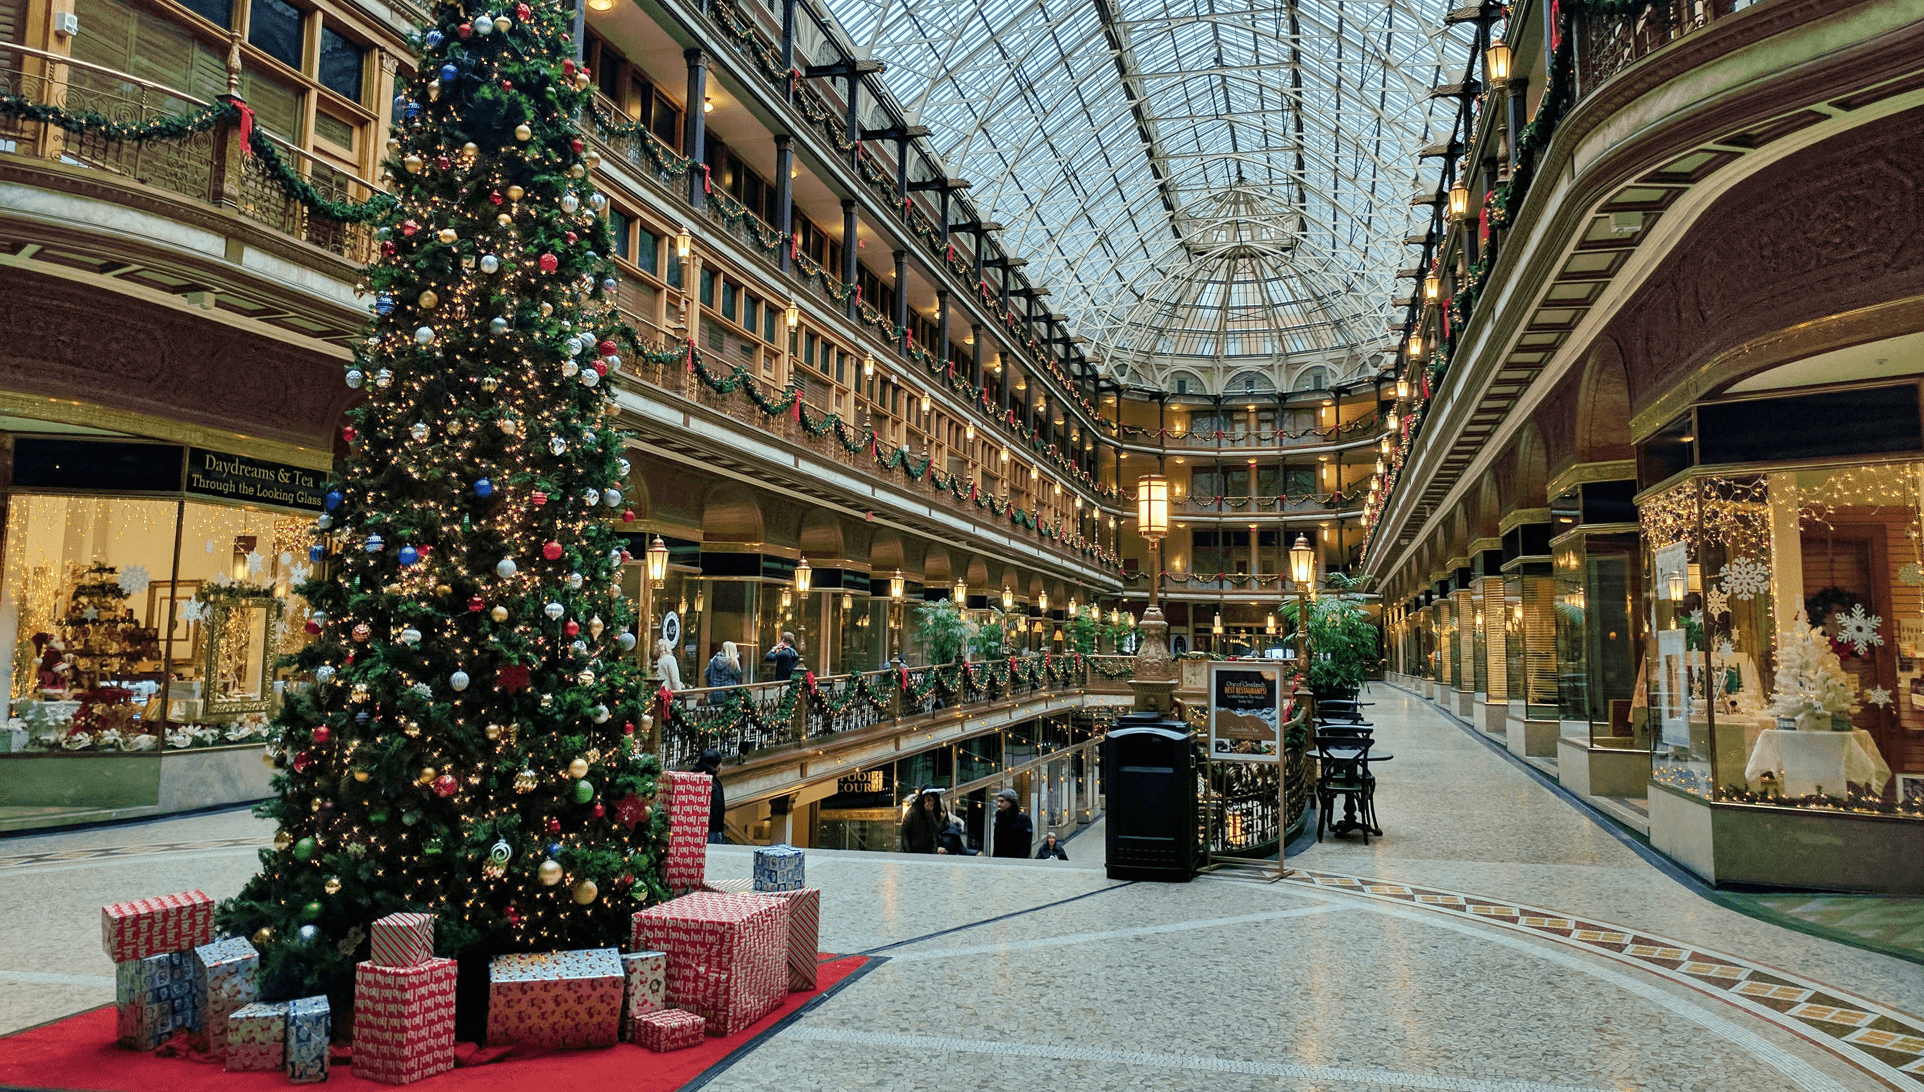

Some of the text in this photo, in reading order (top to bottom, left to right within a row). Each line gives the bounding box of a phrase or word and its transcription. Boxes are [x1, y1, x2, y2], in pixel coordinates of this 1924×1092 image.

[205, 454, 314, 488] Daydreams & Tea
[192, 474, 322, 506] Through the Looking Glass
[1224, 686, 1235, 694] BEST
[838, 782, 877, 793] COUR
